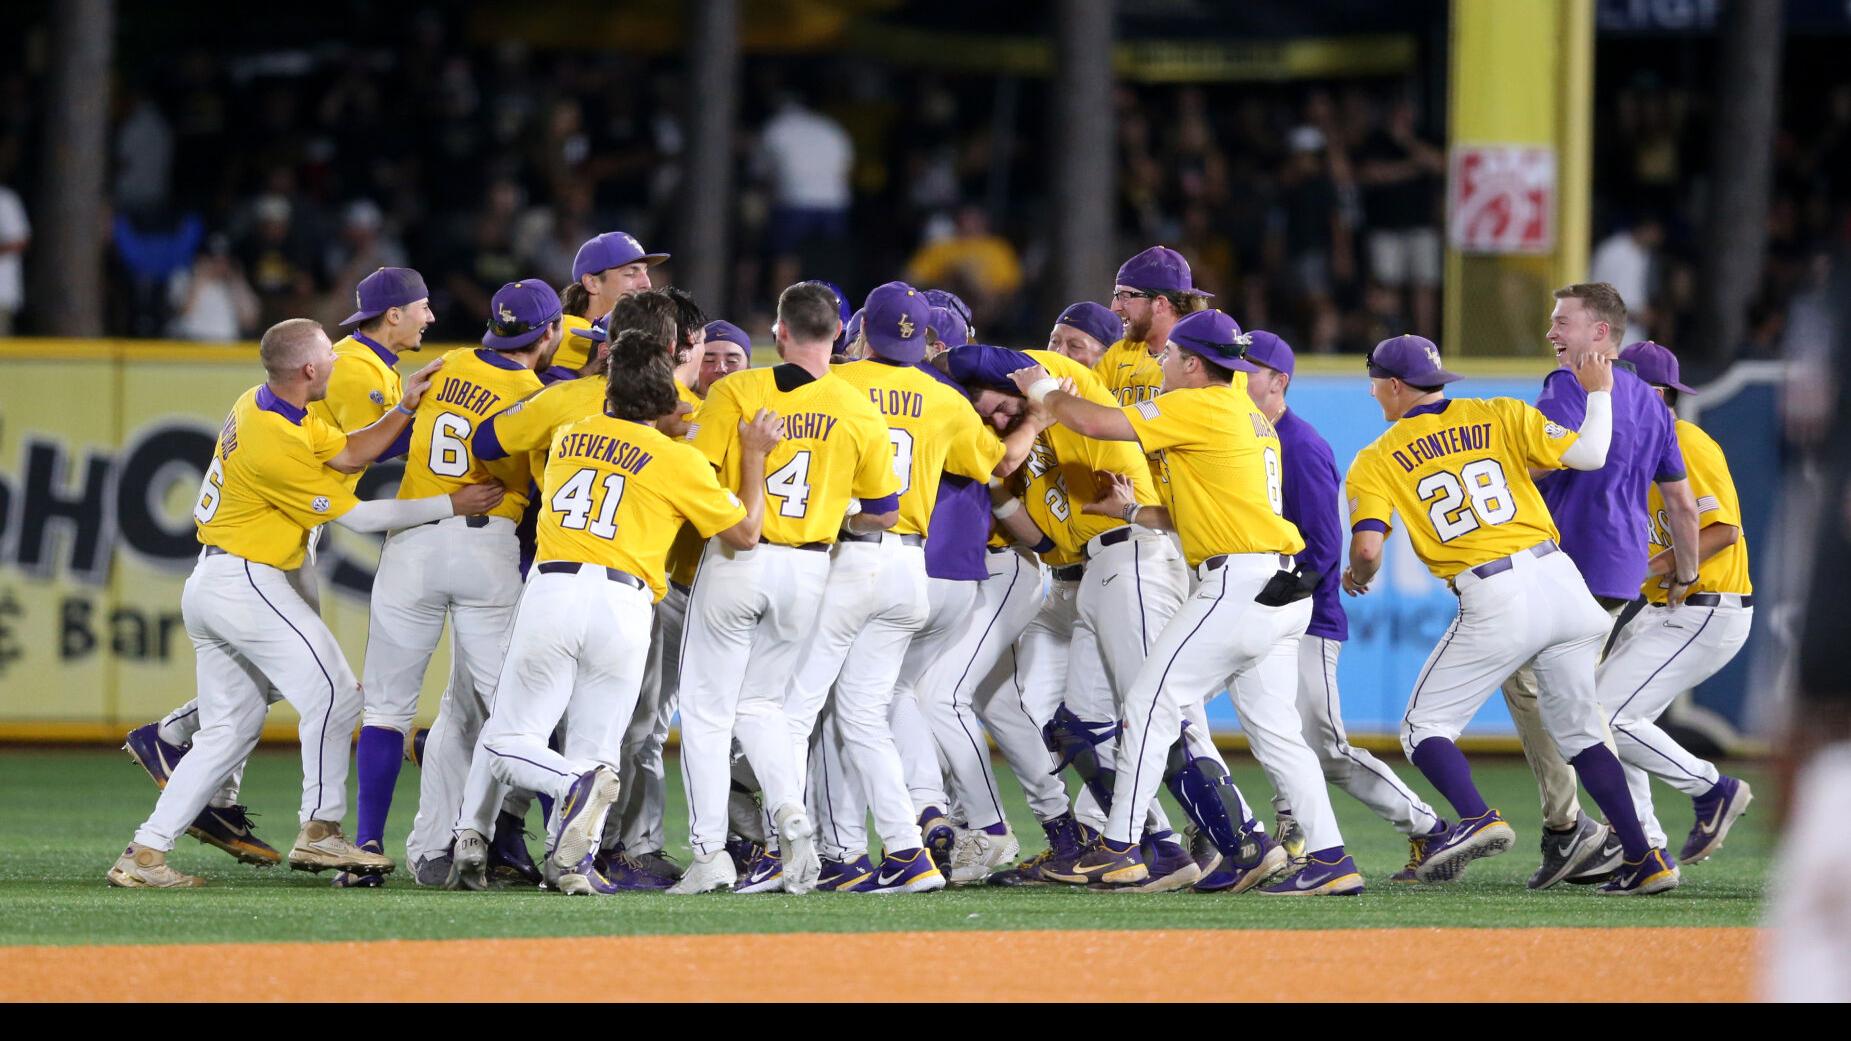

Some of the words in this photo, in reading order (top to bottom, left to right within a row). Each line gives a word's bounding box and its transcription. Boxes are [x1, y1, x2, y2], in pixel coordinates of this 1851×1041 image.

[898, 313, 914, 338] LSU
[436, 377, 501, 416] JOBERT
[869, 388, 923, 418] FLOYD
[428, 411, 472, 477] 6
[559, 433, 653, 476] STEVENSON
[782, 413, 838, 441] UGHTY
[1392, 423, 1492, 473] D.FONTENOT
[551, 468, 626, 541] 41
[765, 450, 811, 518] 4
[1263, 447, 1282, 516] 8
[1416, 457, 1517, 543] 28
[59, 598, 180, 662] Bar
